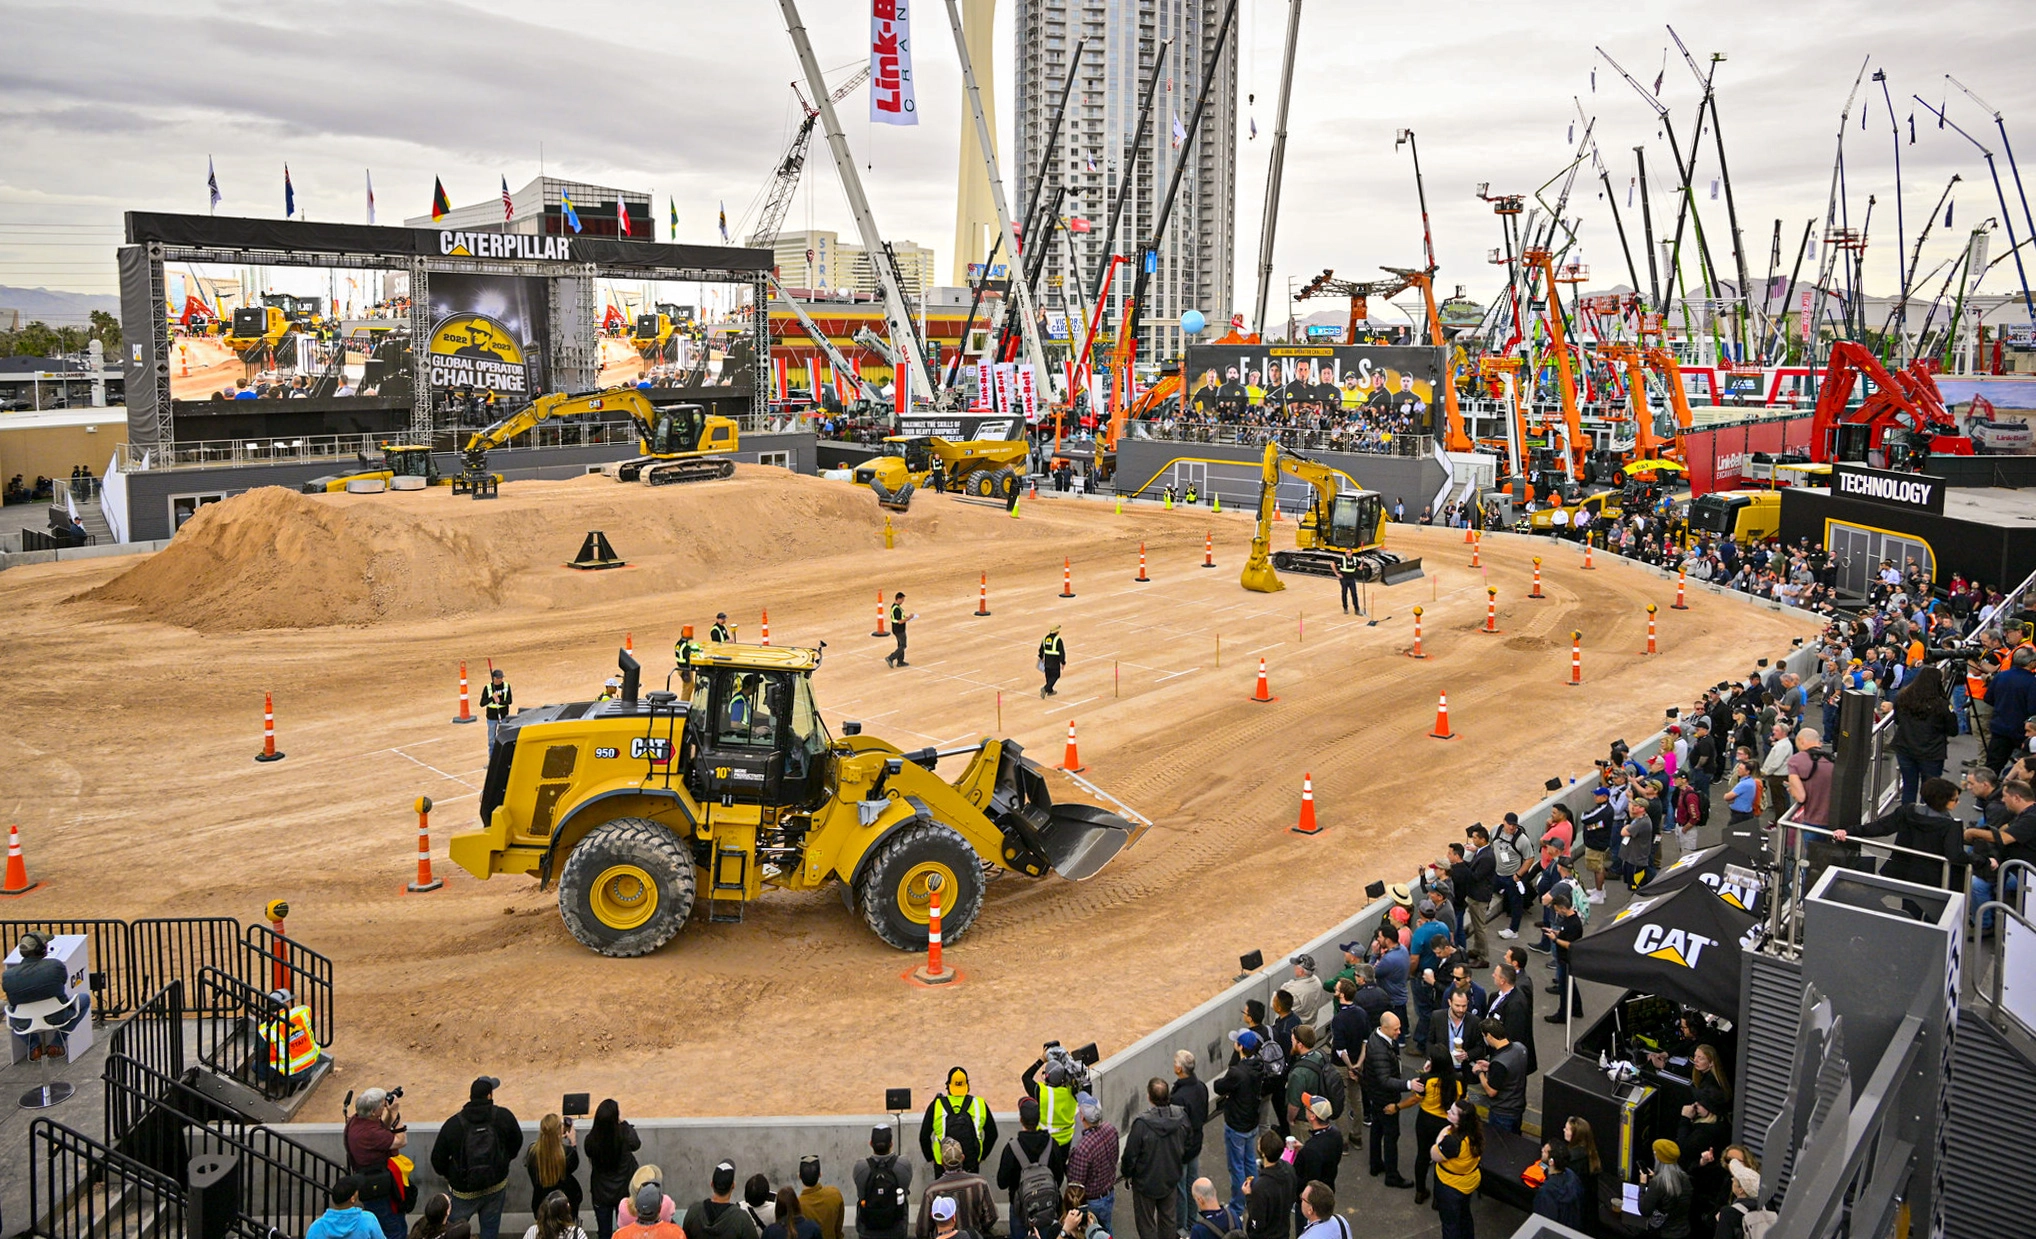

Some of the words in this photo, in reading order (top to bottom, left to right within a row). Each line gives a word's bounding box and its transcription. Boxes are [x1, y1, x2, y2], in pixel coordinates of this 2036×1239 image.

[440, 230, 571, 261] CATERPILLAR
[443, 333, 468, 345] 2022
[491, 341, 511, 351] 2023
[432, 355, 474, 371] GLOBAL
[475, 360, 524, 375] OPERATOR
[431, 367, 526, 392] CHALLENGE
[980, 364, 988, 406] Link-Belt
[995, 371, 1008, 413] ink-Belt
[1021, 371, 1034, 419] Link-Belt
[1717, 452, 1743, 471] Link-Belt
[1839, 471, 1932, 506] TECHNOLOGY
[595, 747, 615, 758] 950
[630, 738, 667, 759] CAT
[1699, 872, 1760, 912] CAT
[1633, 923, 1711, 970] CAT
[71, 966, 86, 989] CAT
